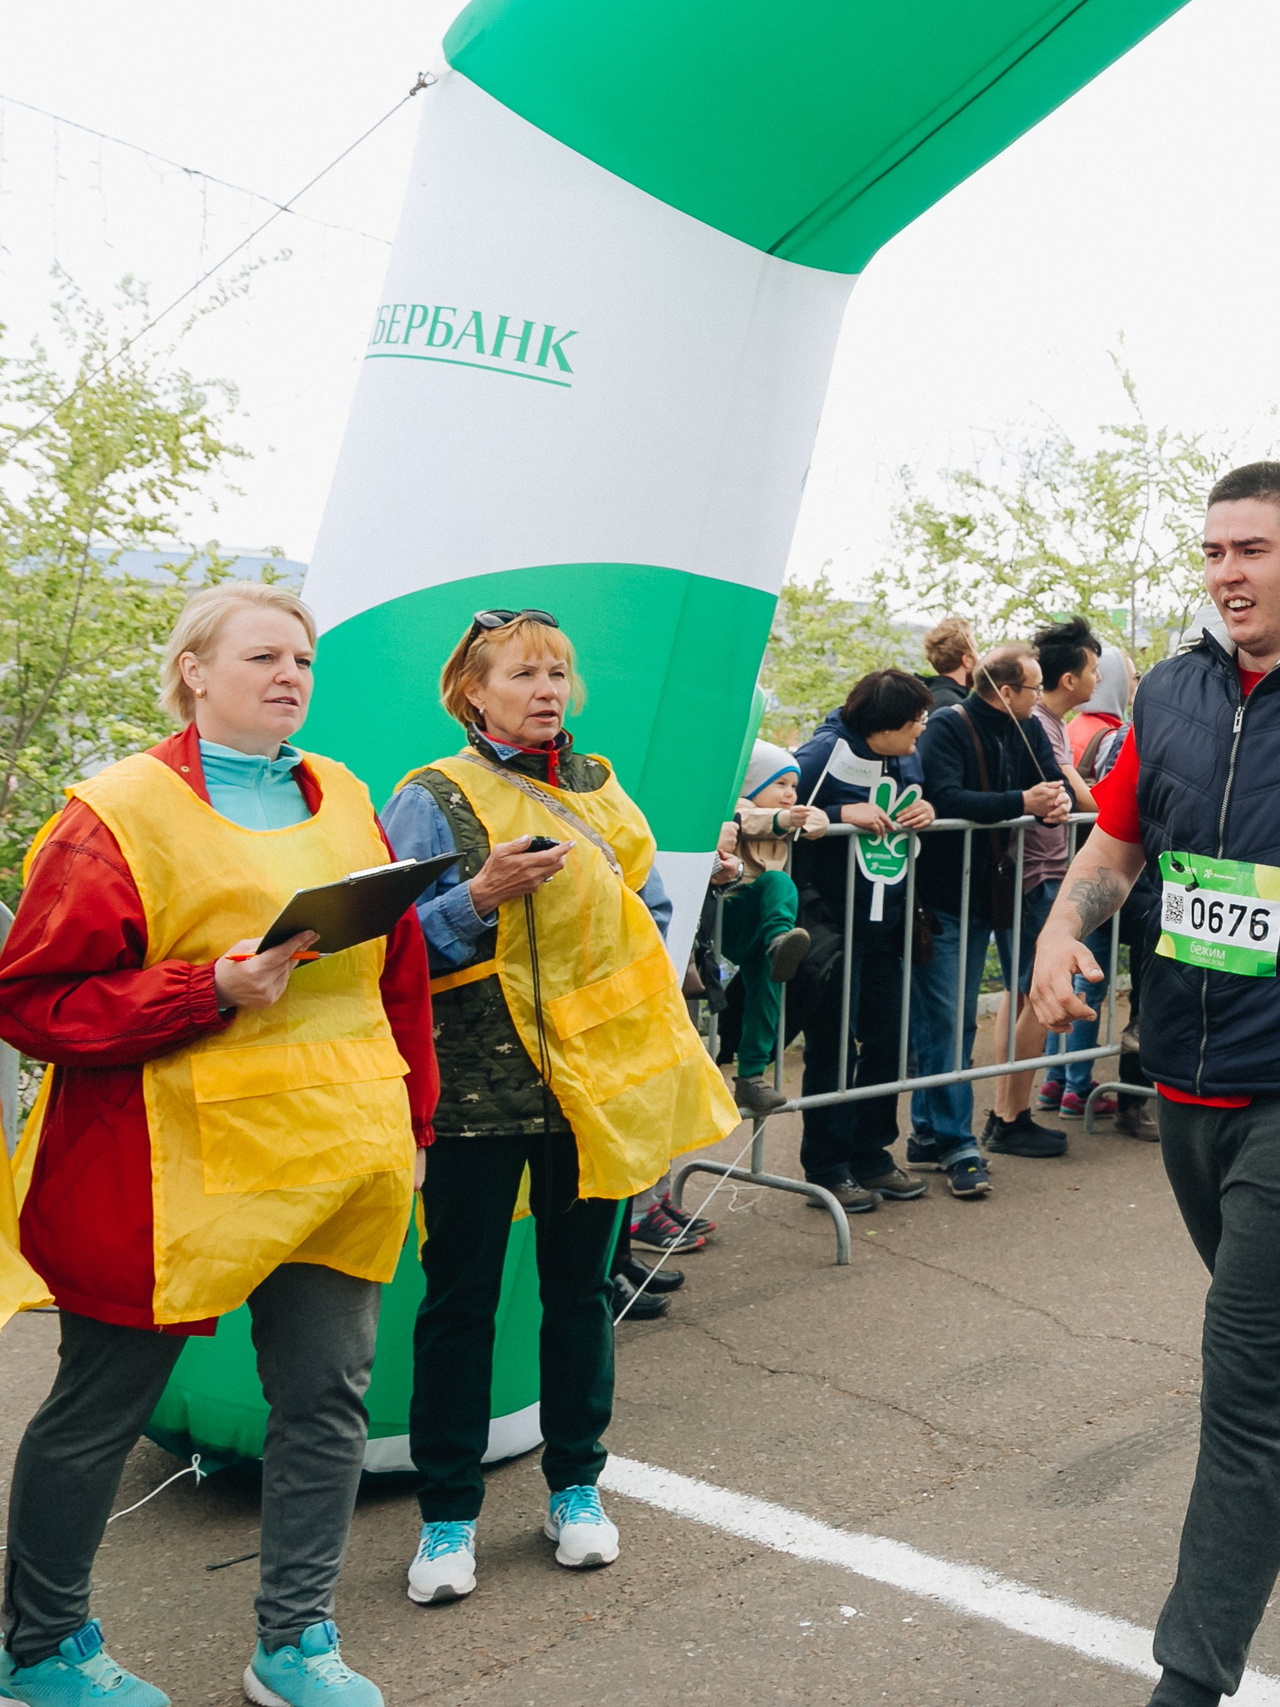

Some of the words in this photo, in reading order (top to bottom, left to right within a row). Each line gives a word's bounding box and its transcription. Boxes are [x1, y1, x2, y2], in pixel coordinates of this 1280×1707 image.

[368, 304, 580, 374] БЕРБАНК
[1191, 897, 1271, 941] 0676
[1190, 941, 1226, 960] бежим
